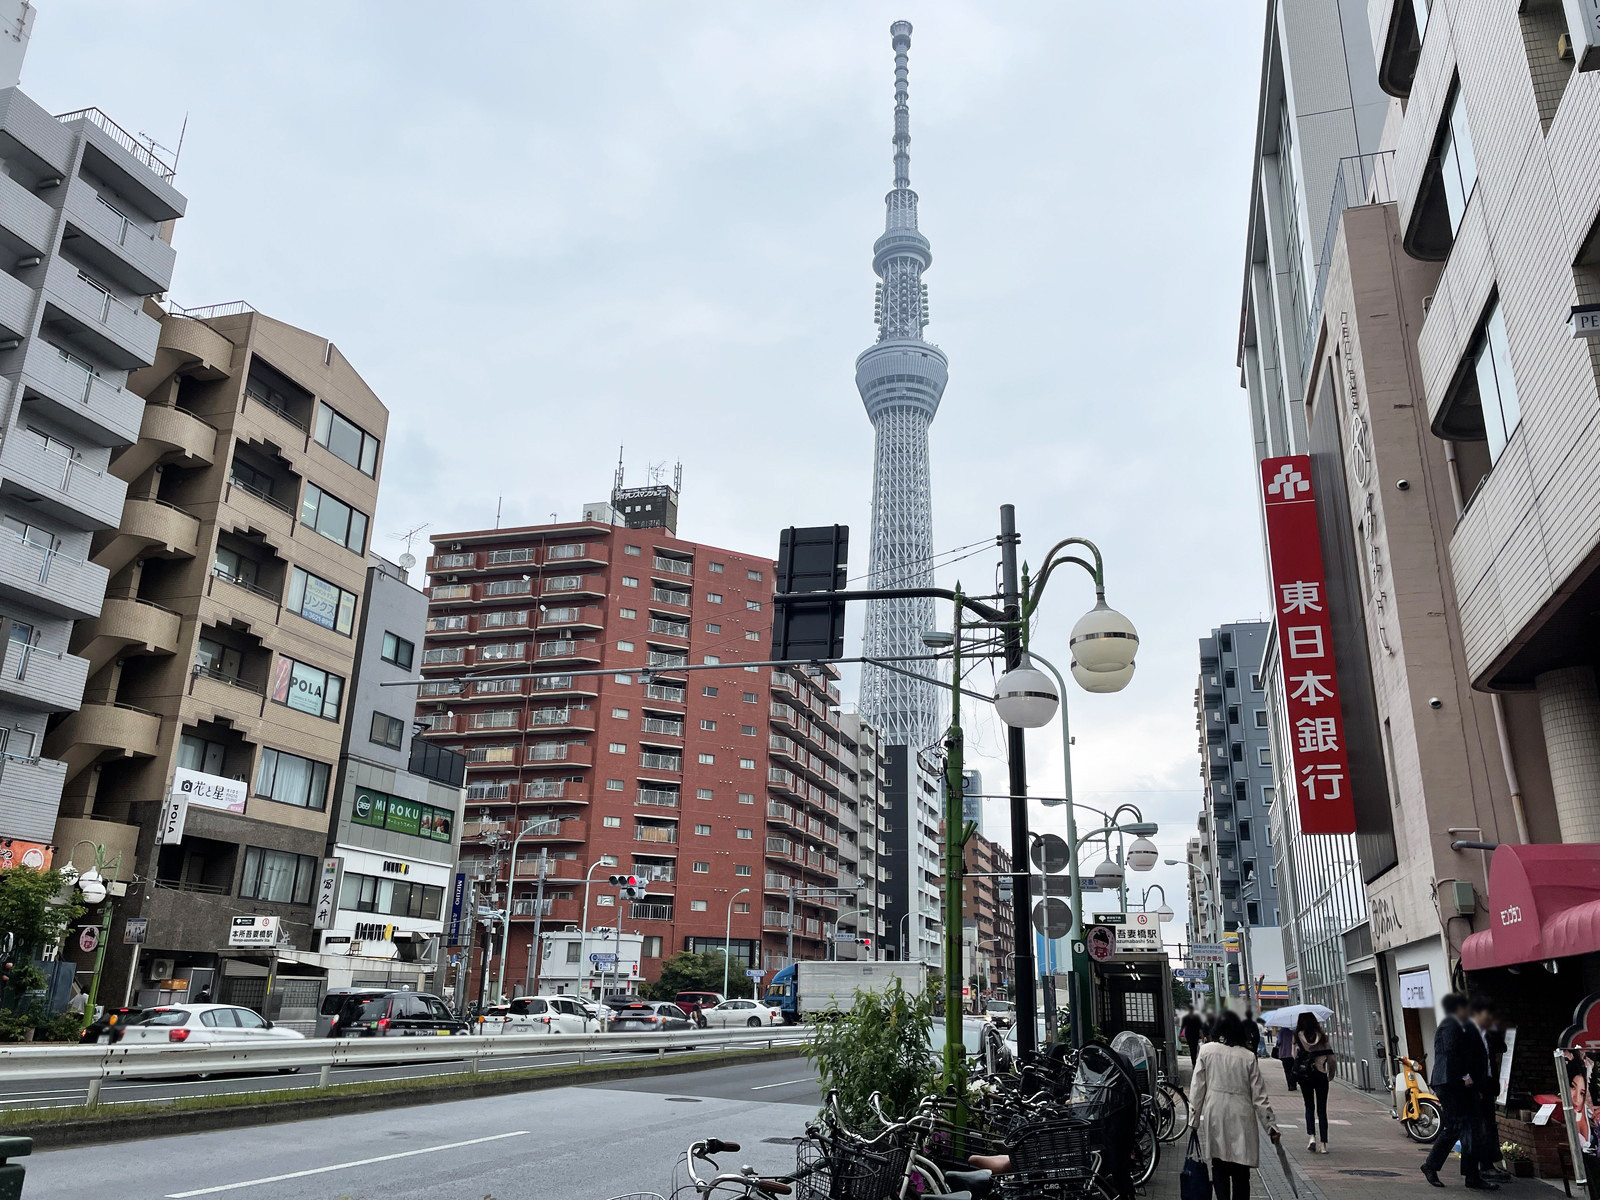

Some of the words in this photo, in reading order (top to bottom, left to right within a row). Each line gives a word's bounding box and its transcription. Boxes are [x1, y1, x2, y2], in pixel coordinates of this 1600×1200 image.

[290, 676, 322, 698] POLA
[1279, 580, 1345, 802] 東日本銀行
[193, 780, 224, 801] 花と星
[168, 804, 179, 833] POLA
[1117, 929, 1157, 939] 吾妻橋駅
